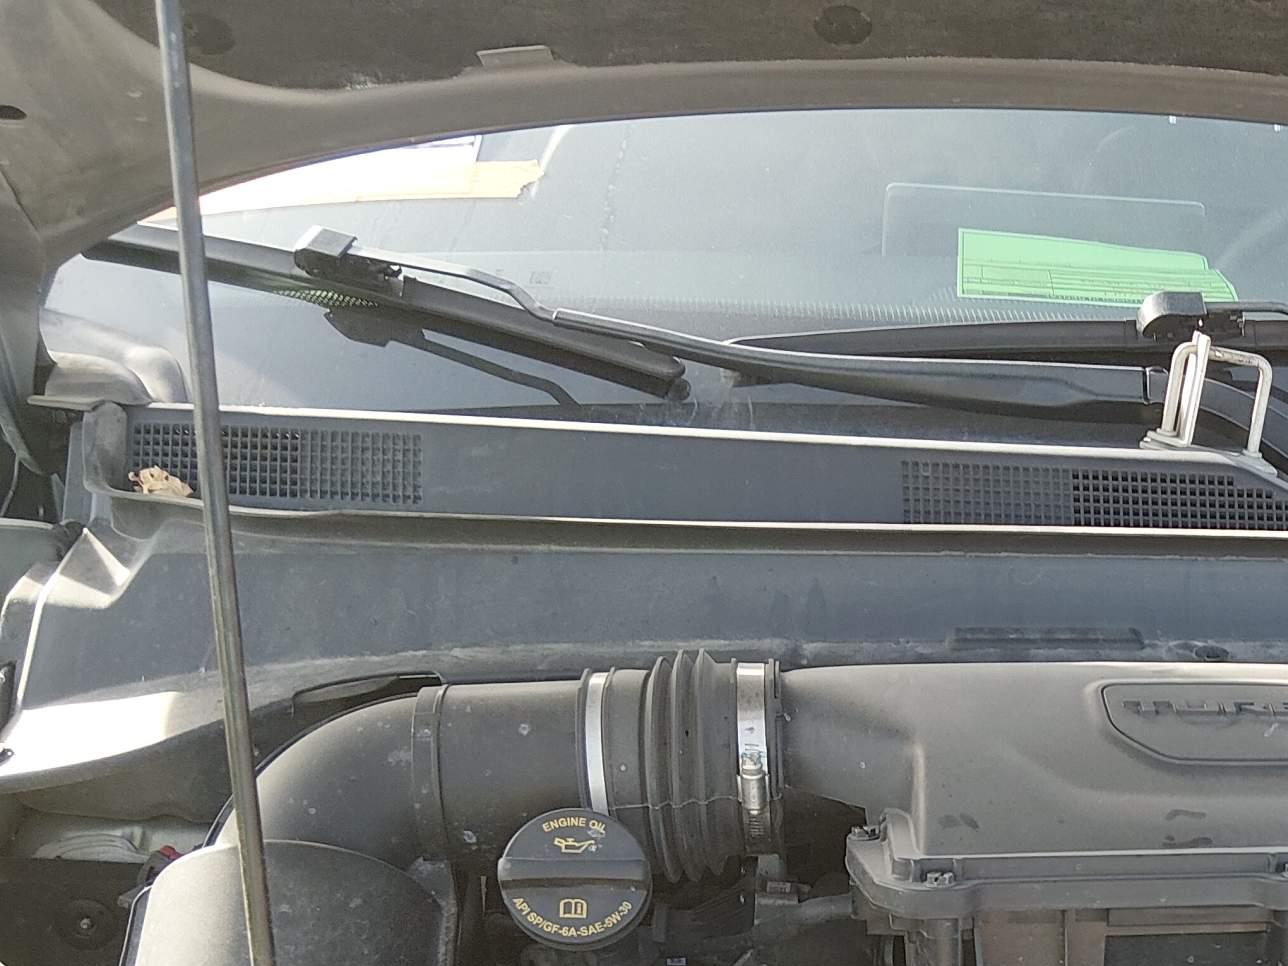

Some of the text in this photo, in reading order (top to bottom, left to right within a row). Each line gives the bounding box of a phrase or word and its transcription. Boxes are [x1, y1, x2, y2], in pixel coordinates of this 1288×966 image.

[542, 816, 607, 834] ENGINE OIL
[512, 897, 531, 916] API
